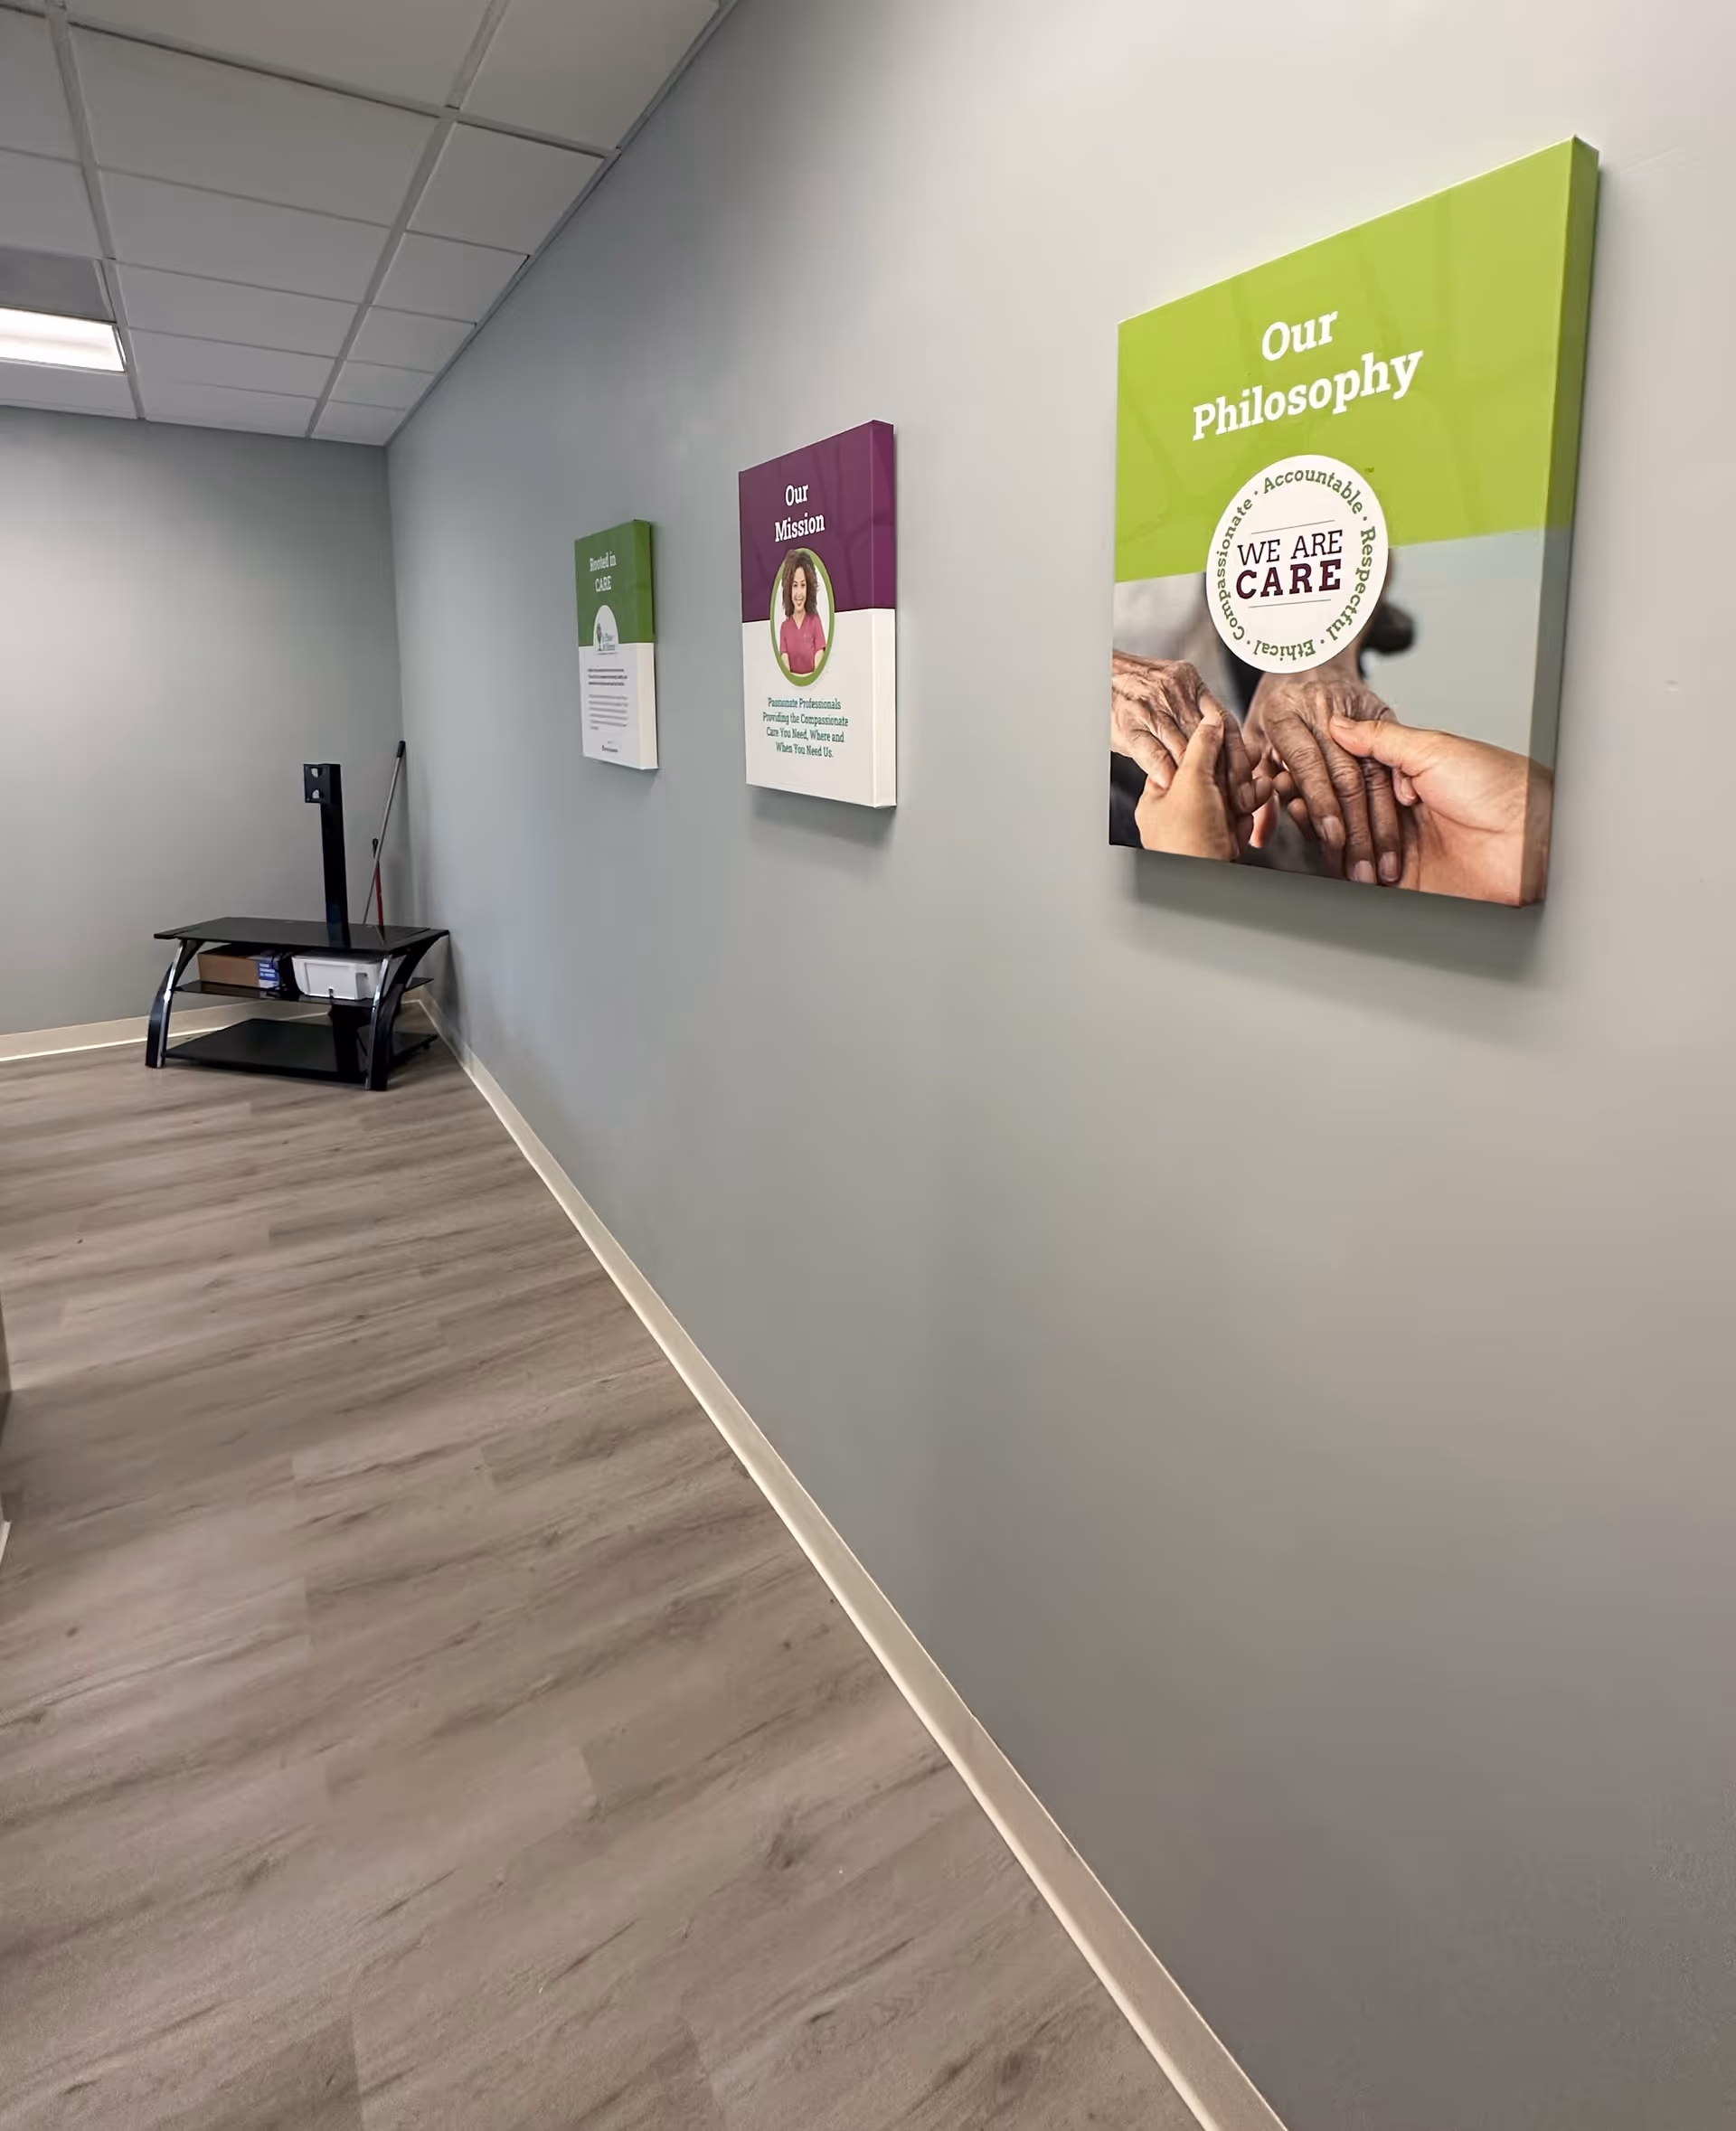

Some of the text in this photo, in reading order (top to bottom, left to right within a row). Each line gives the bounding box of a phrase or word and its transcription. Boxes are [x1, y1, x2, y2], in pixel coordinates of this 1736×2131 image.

[1262, 311, 1338, 362] Our
[1193, 350, 1423, 441] Philosophy
[785, 484, 809, 506] Our
[774, 512, 826, 542] Mission
[1237, 529, 1343, 566] WE ARE
[590, 550, 617, 572] Rooted in
[1215, 469, 1376, 661] Accountable Respectful Ethical Compassionate
[594, 575, 612, 592] CARE
[1235, 558, 1342, 599] CARE
[799, 697, 841, 710] Professionals
[762, 712, 848, 727] Providing the Compassionate
[767, 727, 844, 742] Care You Need, Where and
[776, 741, 834, 758] When You Need Us.
